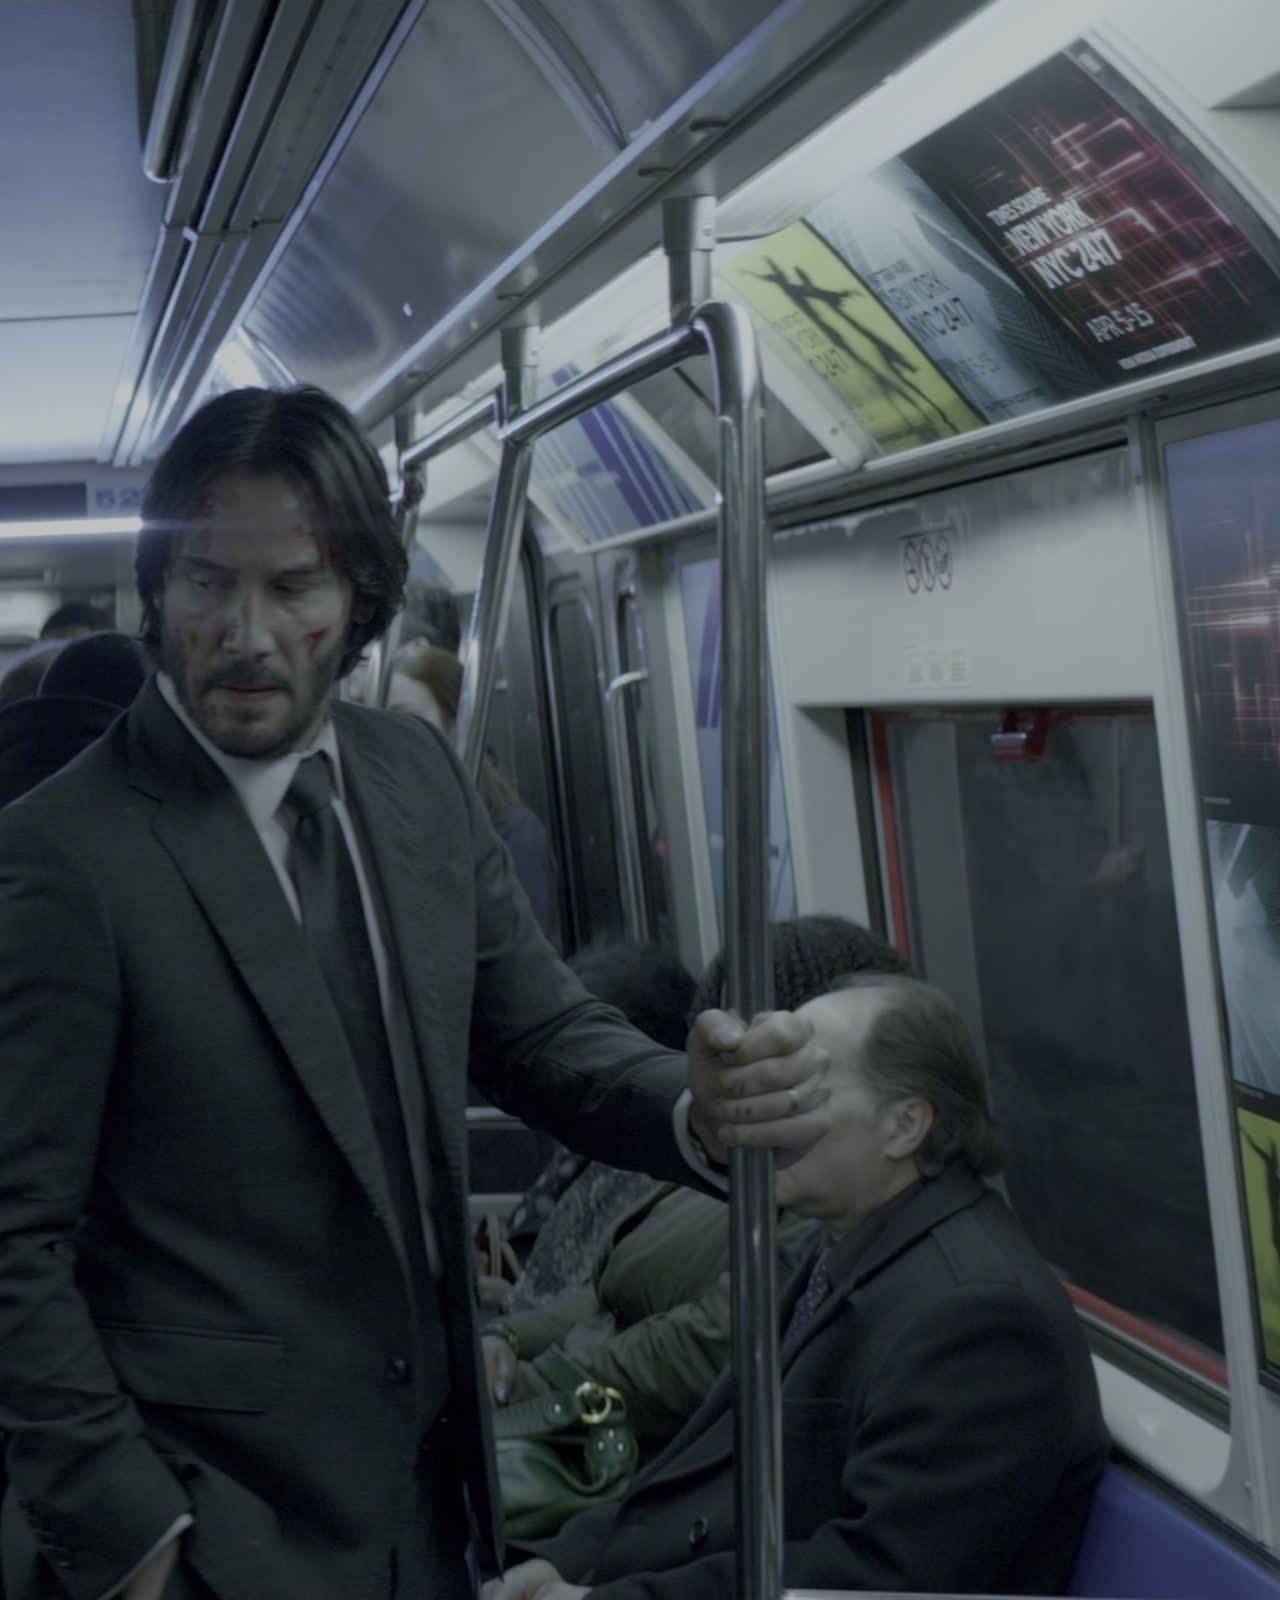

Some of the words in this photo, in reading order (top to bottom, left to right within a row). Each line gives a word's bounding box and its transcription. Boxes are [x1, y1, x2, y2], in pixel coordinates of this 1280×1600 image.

[1003, 214, 1051, 256] NEW
[1038, 198, 1095, 242] YORK
[1029, 247, 1086, 290] NYC
[1071, 226, 1124, 273] 24/7
[905, 309, 947, 341] NYC
[933, 297, 975, 332] 24/7
[1085, 312, 1126, 344] APR
[1111, 301, 1156, 332] 5-15
